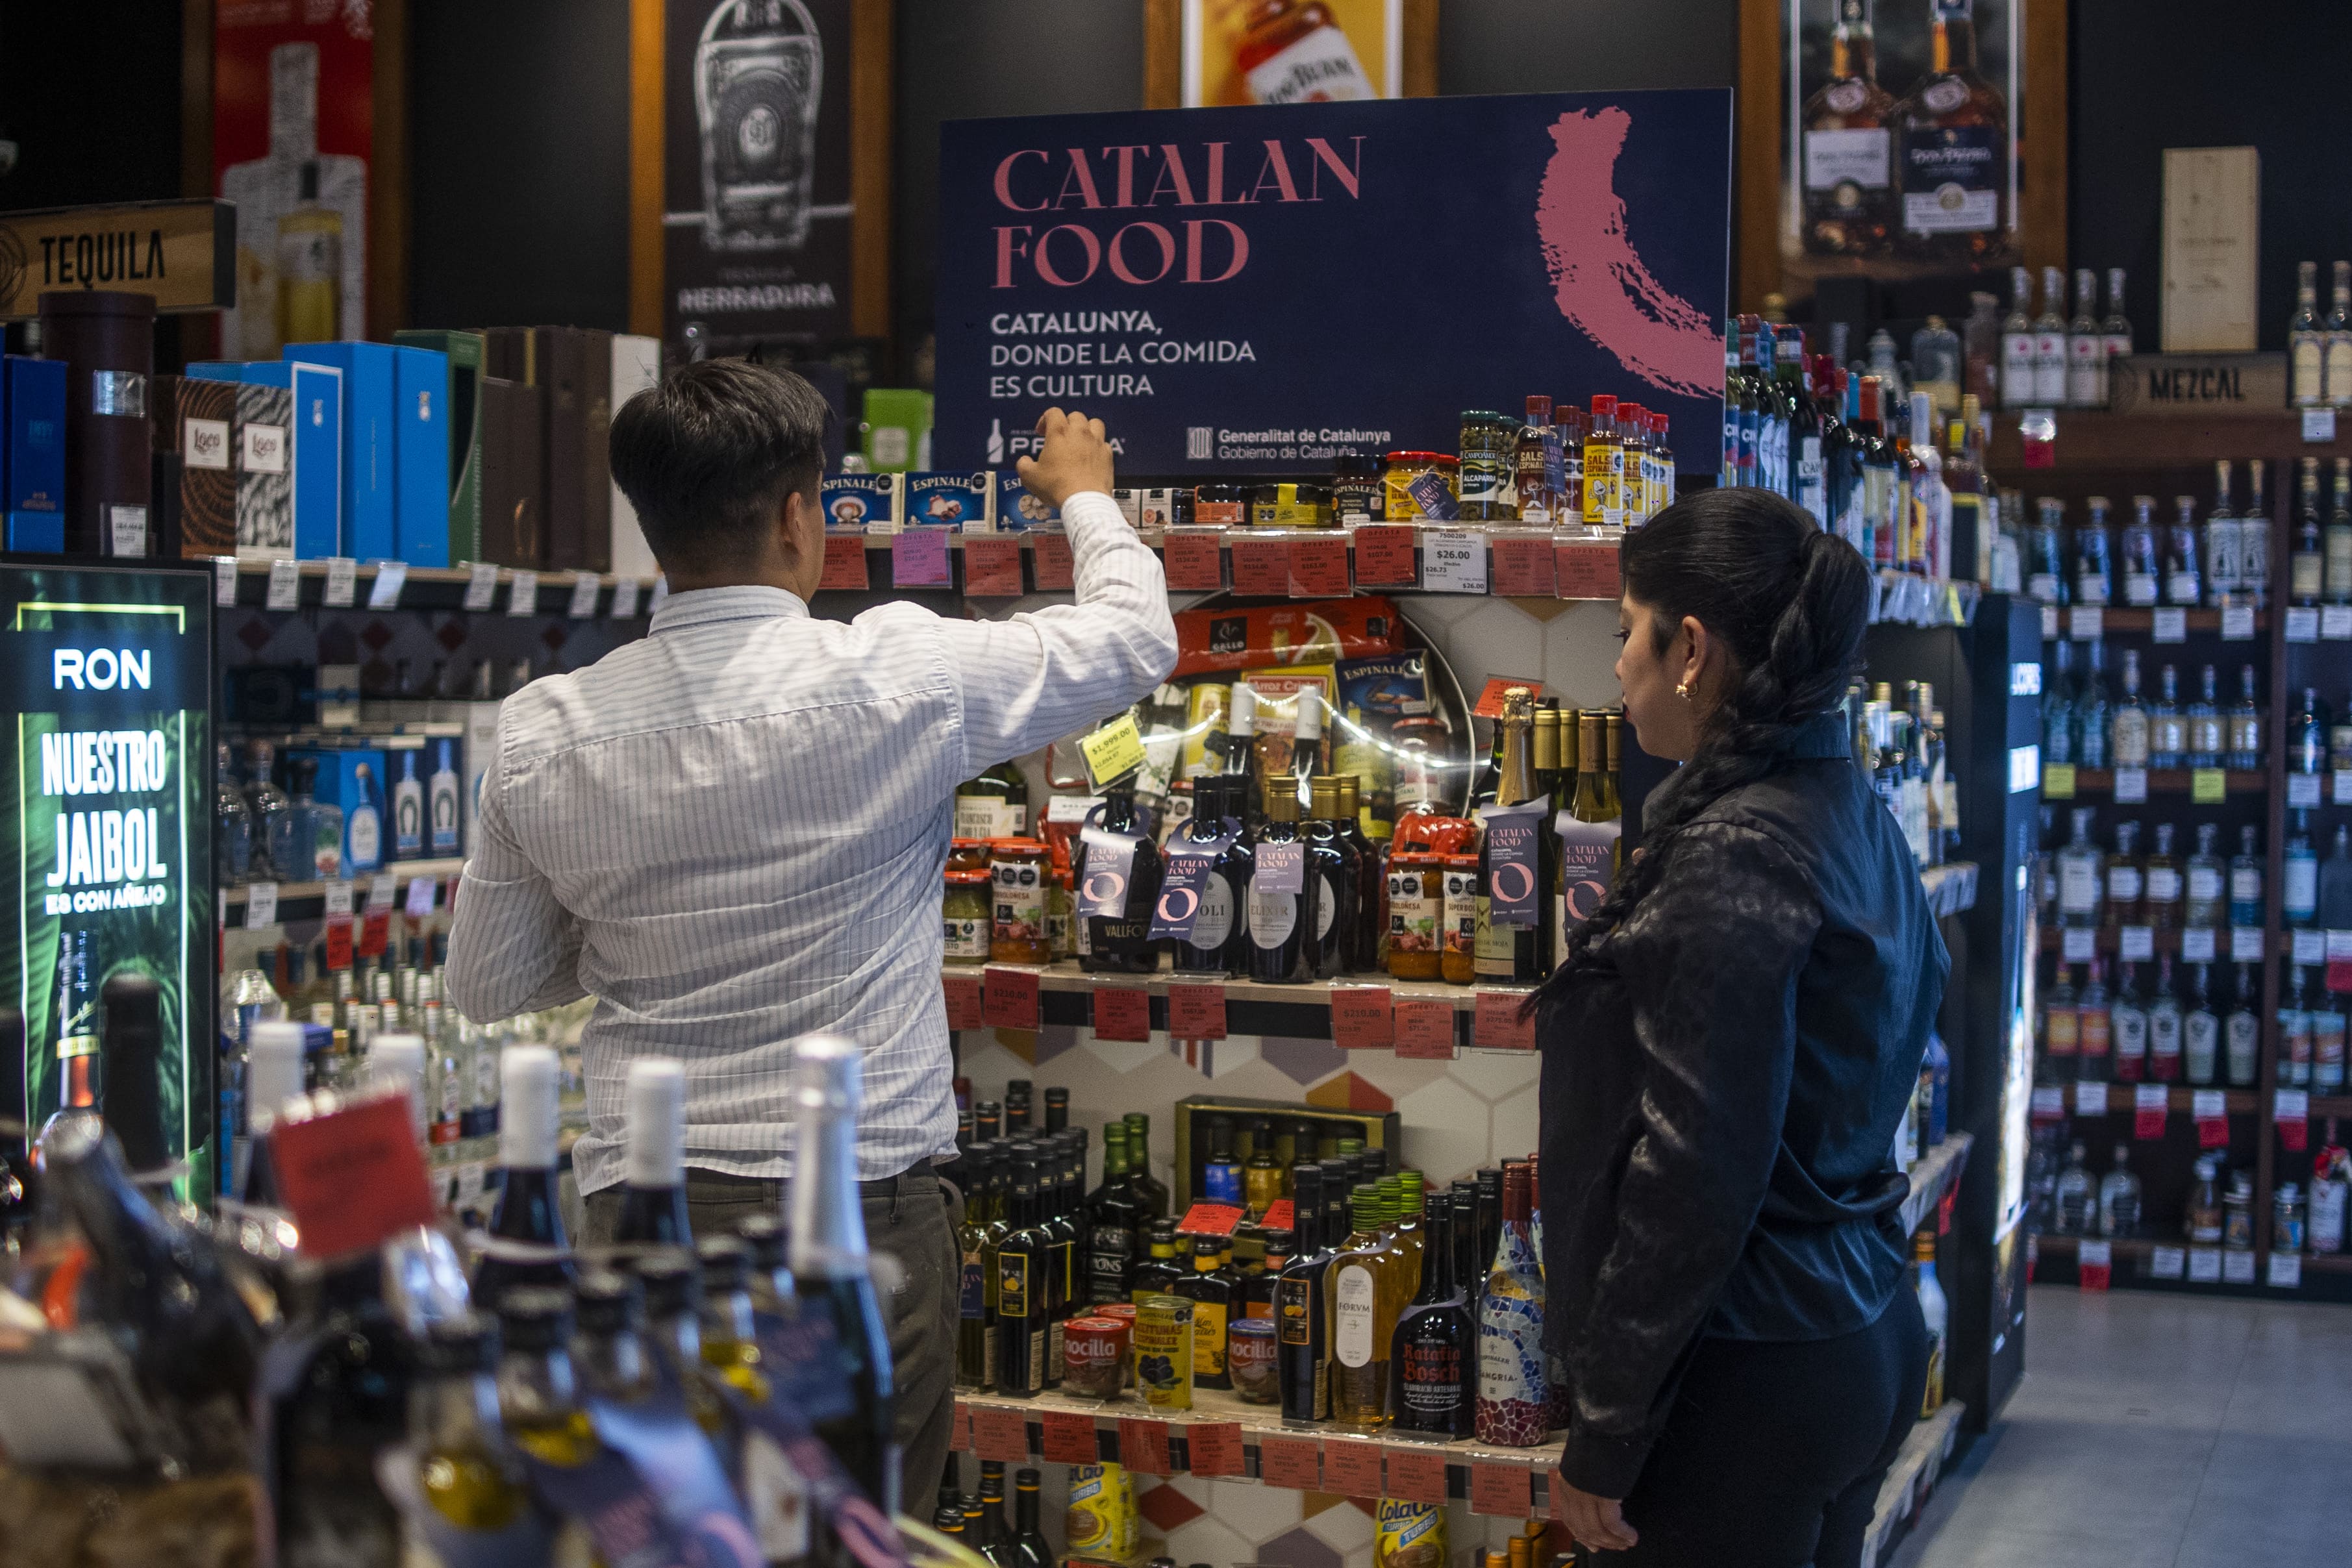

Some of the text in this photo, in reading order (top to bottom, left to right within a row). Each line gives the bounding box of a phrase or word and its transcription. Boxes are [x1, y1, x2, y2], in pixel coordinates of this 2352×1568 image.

[992, 136, 1367, 213] CATALAN
[40, 230, 165, 290] TEQUILA
[991, 219, 1250, 290] FOOD
[991, 310, 1163, 337] CATALUNYA,
[991, 340, 1257, 366] DONDE LA COMIDA
[991, 374, 1155, 397] ES CULTURA
[2150, 368, 2244, 403] MEZCAL
[1218, 429, 1391, 446] Generalitat de Catalunya
[1218, 445, 1277, 459] Gobierno
[1281, 445, 1298, 458] de
[1520, 451, 1544, 462] SALS
[1586, 454, 1612, 466] SALS
[1586, 464, 1612, 473] ESPINAL
[821, 477, 877, 491] SPINALE
[912, 477, 971, 492] ESPINALE
[1437, 551, 1470, 559] $26.00
[54, 648, 151, 690] RON
[1343, 664, 1404, 680] ESPINALE
[42, 729, 167, 797] NUESTRO
[1490, 828, 1533, 838] CATALAN
[47, 808, 168, 888] JAIBOL
[1491, 838, 1521, 847] FOOD
[1258, 852, 1301, 861] CATALAN
[1566, 845, 1610, 855] CATALAN
[1088, 854, 1118, 862] FOOD
[1170, 860, 1208, 868] CATALAN
[1258, 860, 1288, 869] FOOD
[1566, 855, 1597, 864] FOOD
[1169, 867, 1196, 875] FOOD
[45, 882, 167, 915] ES CON AÑEJO
[1105, 925, 1145, 938] VALLFO
[1403, 1343, 1460, 1361] Ratafia
[1403, 1360, 1460, 1382] Bosch
